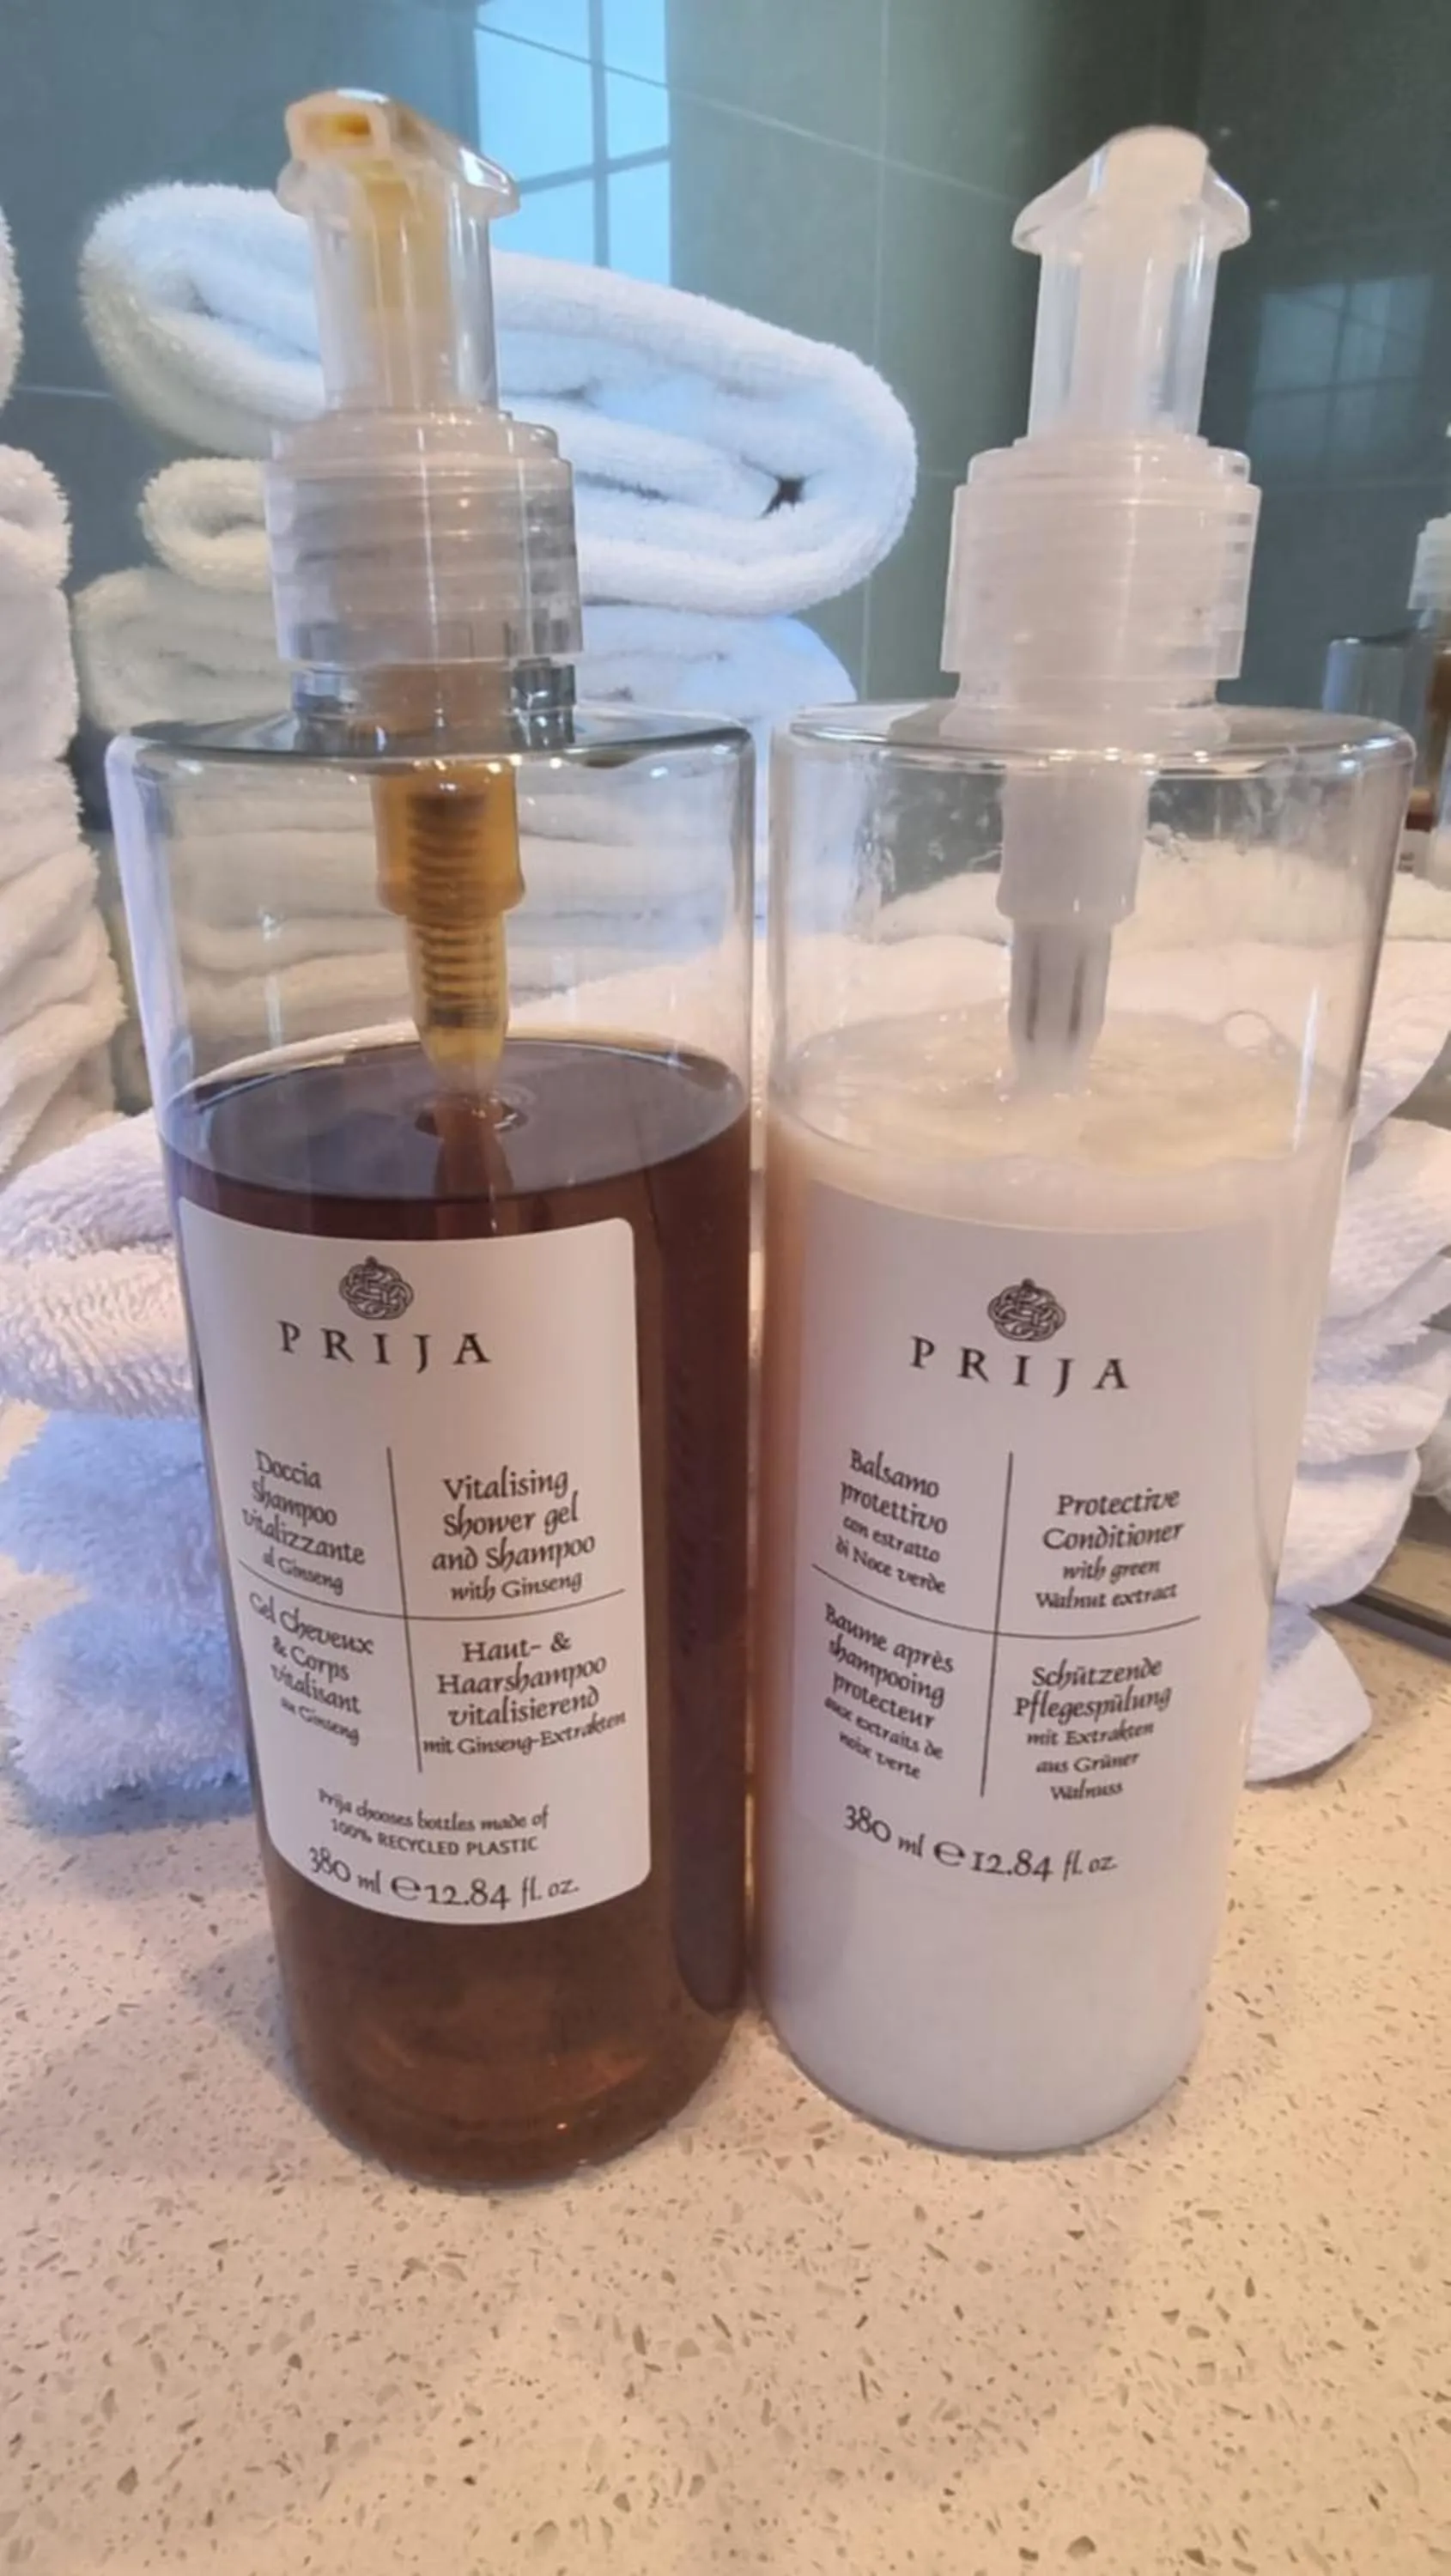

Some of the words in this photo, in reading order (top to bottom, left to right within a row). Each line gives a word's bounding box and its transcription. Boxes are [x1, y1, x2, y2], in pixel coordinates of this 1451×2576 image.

[276, 1321, 490, 1373] PRIJA
[911, 1336, 1129, 1397] PRIJA
[255, 1450, 321, 1489] Doccia
[442, 1465, 568, 1501] Vitalising
[850, 1449, 939, 1498] Balsamo
[443, 1504, 536, 1540] Shower
[544, 1492, 580, 1535] gel
[841, 1481, 948, 1534] protettivo
[1056, 1488, 1181, 1517] Protective
[242, 1509, 366, 1565] vitalizzante
[432, 1545, 477, 1571] and
[486, 1534, 596, 1571] Shampoo
[843, 1516, 869, 1537] con
[872, 1528, 940, 1563] estratto
[1043, 1521, 1184, 1550] Conditioner
[279, 1556, 344, 1595] Ginseng
[835, 1535, 849, 1558] di
[853, 1545, 891, 1577] Noce
[896, 1569, 946, 1594] verde
[1062, 1554, 1106, 1581] with
[1110, 1559, 1160, 1583] green
[451, 1577, 495, 1602] with
[501, 1571, 582, 1598] Ginseng
[1035, 1586, 1107, 1608] Walnut
[1112, 1583, 1177, 1607] extract
[250, 1592, 276, 1625] Gel
[280, 1607, 373, 1655] Cheveux
[550, 1631, 572, 1651] &
[824, 1603, 887, 1651] Baume
[893, 1639, 954, 1673] après
[272, 1636, 288, 1656] &
[290, 1643, 349, 1682] Corps
[437, 1656, 606, 1697] Haarshampoo
[1032, 1657, 1163, 1689] Schützende
[270, 1664, 361, 1714] vitalisant
[448, 1686, 599, 1728] vitalisierend
[832, 1673, 935, 1729] protecteur
[1014, 1685, 1172, 1724] Pflegespülung
[299, 1704, 359, 1746] Ginseng
[423, 1735, 453, 1754] mit
[458, 1711, 626, 1755] Ginseng-Extrakten
[857, 1716, 920, 1752] extraits
[924, 1740, 944, 1759] de
[1027, 1727, 1059, 1747] mit
[1065, 1720, 1154, 1747] Extrakten
[839, 1730, 871, 1758] noix
[876, 1752, 920, 1778] verte
[1035, 1759, 1069, 1774] aus
[1073, 1751, 1140, 1773] Grüner
[1050, 1778, 1123, 1801] Walnuss
[356, 1799, 413, 1828] chooses
[417, 1808, 475, 1832] bottles
[480, 1811, 526, 1831] made
[532, 1804, 549, 1829] of
[378, 1833, 458, 1856] RECYCLED
[466, 1836, 538, 1856] PLASTIC
[843, 1804, 891, 1842] 380
[897, 1832, 925, 1858] ml
[971, 1850, 1053, 1881] 12.84
[309, 1846, 351, 1882] 380
[357, 1870, 381, 1893] ml
[425, 1879, 511, 1910] 12.84
